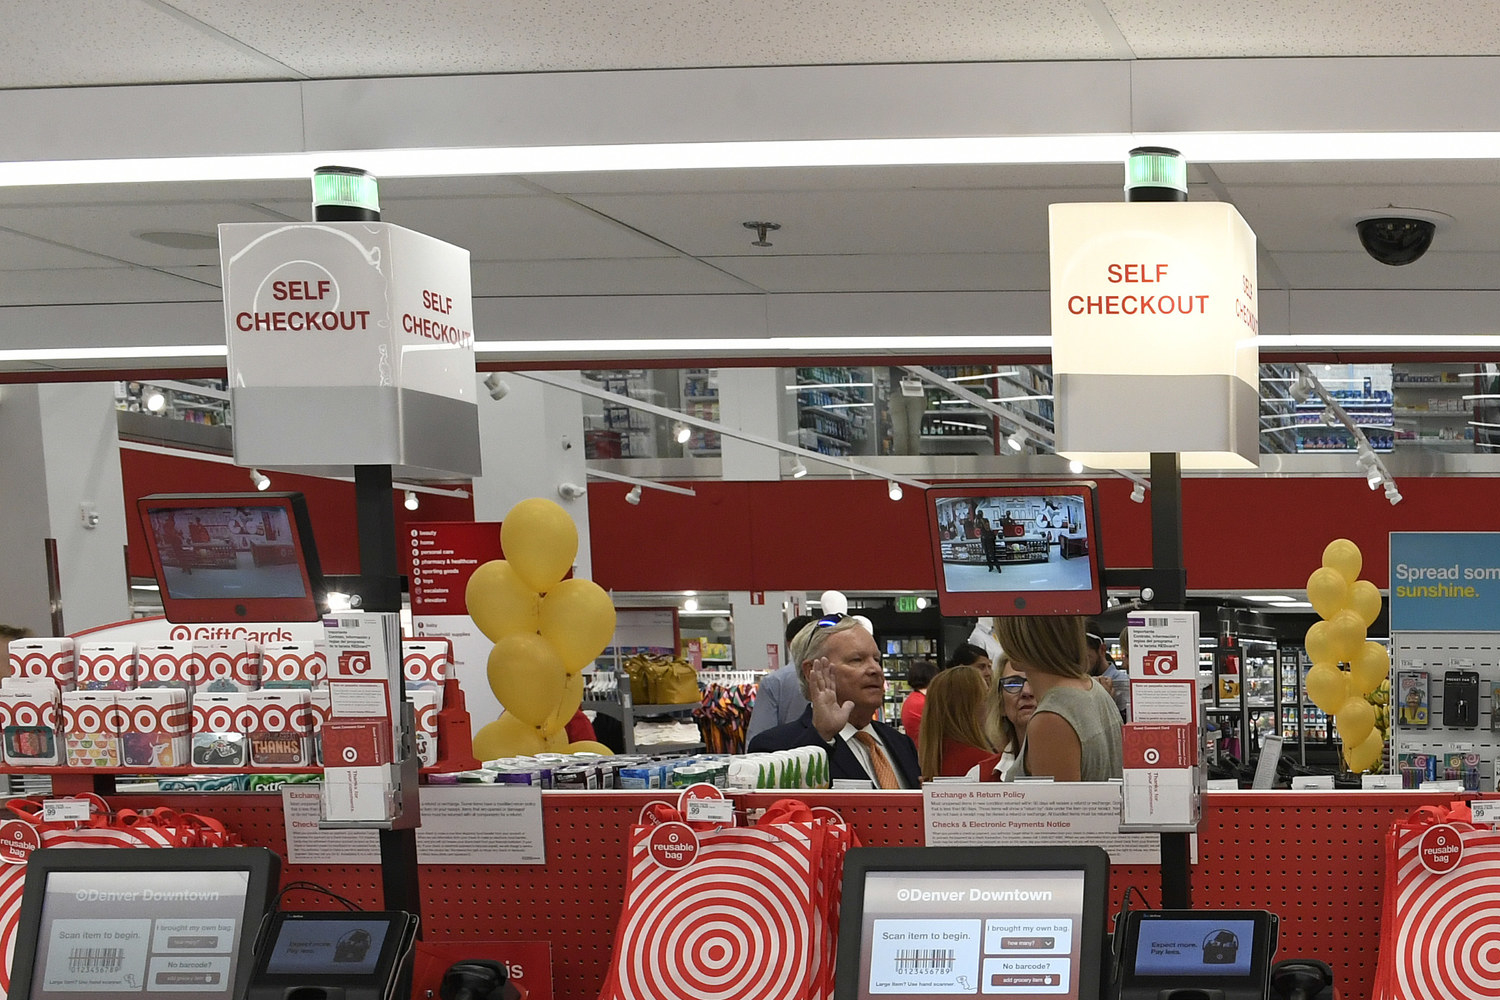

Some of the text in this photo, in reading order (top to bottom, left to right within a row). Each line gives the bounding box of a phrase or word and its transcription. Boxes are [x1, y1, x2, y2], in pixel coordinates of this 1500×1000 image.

[1108, 264, 1168, 283] SELF
[273, 281, 330, 300] SELF
[423, 290, 452, 315] SELF
[1068, 296, 1209, 314] CHECKOUT
[236, 311, 369, 331] CHECKOUT
[403, 314, 471, 349] CHECKOUT
[1396, 564, 1459, 582] Spread
[1396, 583, 1480, 598] sunshine.
[195, 628, 292, 644] GiftCards
[253, 741, 299, 753] THANKS
[1008, 821, 1044, 829] Payments
[0, 839, 35, 851] reusable
[654, 843, 694, 851] reusable
[1424, 845, 1459, 854] reusable
[9, 847, 25, 857] bag
[665, 851, 682, 860] bag
[1434, 854, 1449, 863] bag
[88, 889, 219, 901] Denver Downtown
[911, 888, 1052, 901] Denver Downtown
[83, 931, 101, 939] item
[104, 931, 112, 939] to
[115, 932, 140, 940] begin.
[883, 932, 906, 940] Scan
[908, 932, 928, 940] item
[943, 932, 971, 941] begin.
